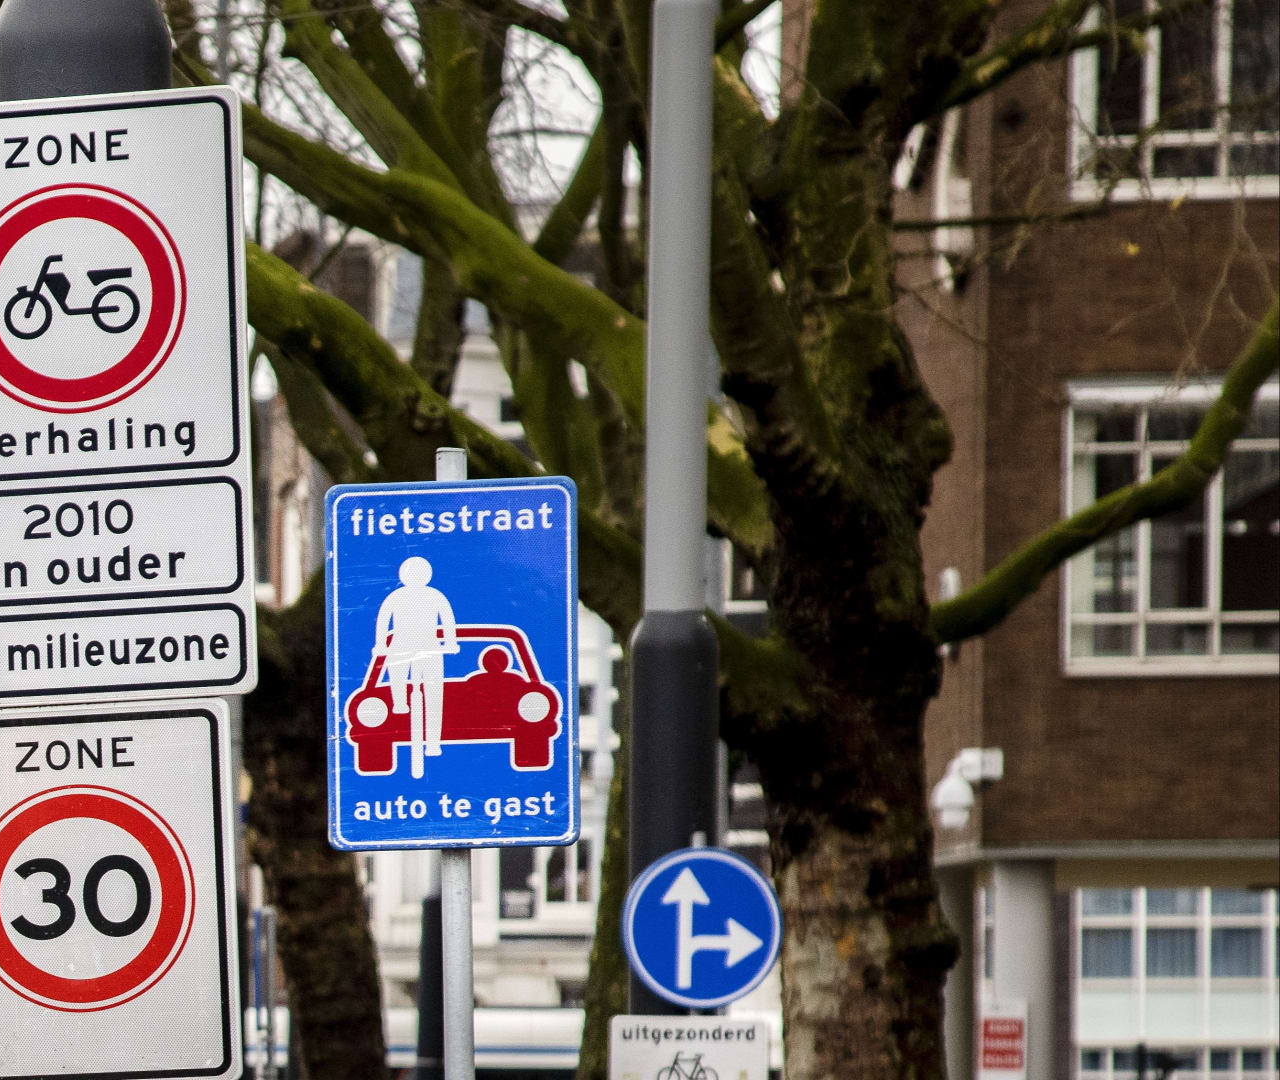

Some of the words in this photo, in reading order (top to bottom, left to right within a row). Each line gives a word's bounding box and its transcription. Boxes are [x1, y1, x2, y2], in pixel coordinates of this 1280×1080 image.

[4, 129, 129, 169] ZONE
[23, 498, 134, 540] 2010
[351, 502, 552, 535] fietsstraat
[46, 546, 186, 585] ouder
[7, 630, 231, 673] milieuzone
[16, 737, 134, 772] ZONE
[354, 796, 426, 821] auto
[439, 794, 471, 818] te
[484, 792, 555, 824] gast
[9, 853, 152, 942] 30
[622, 1024, 756, 1046] uitgezonderd
